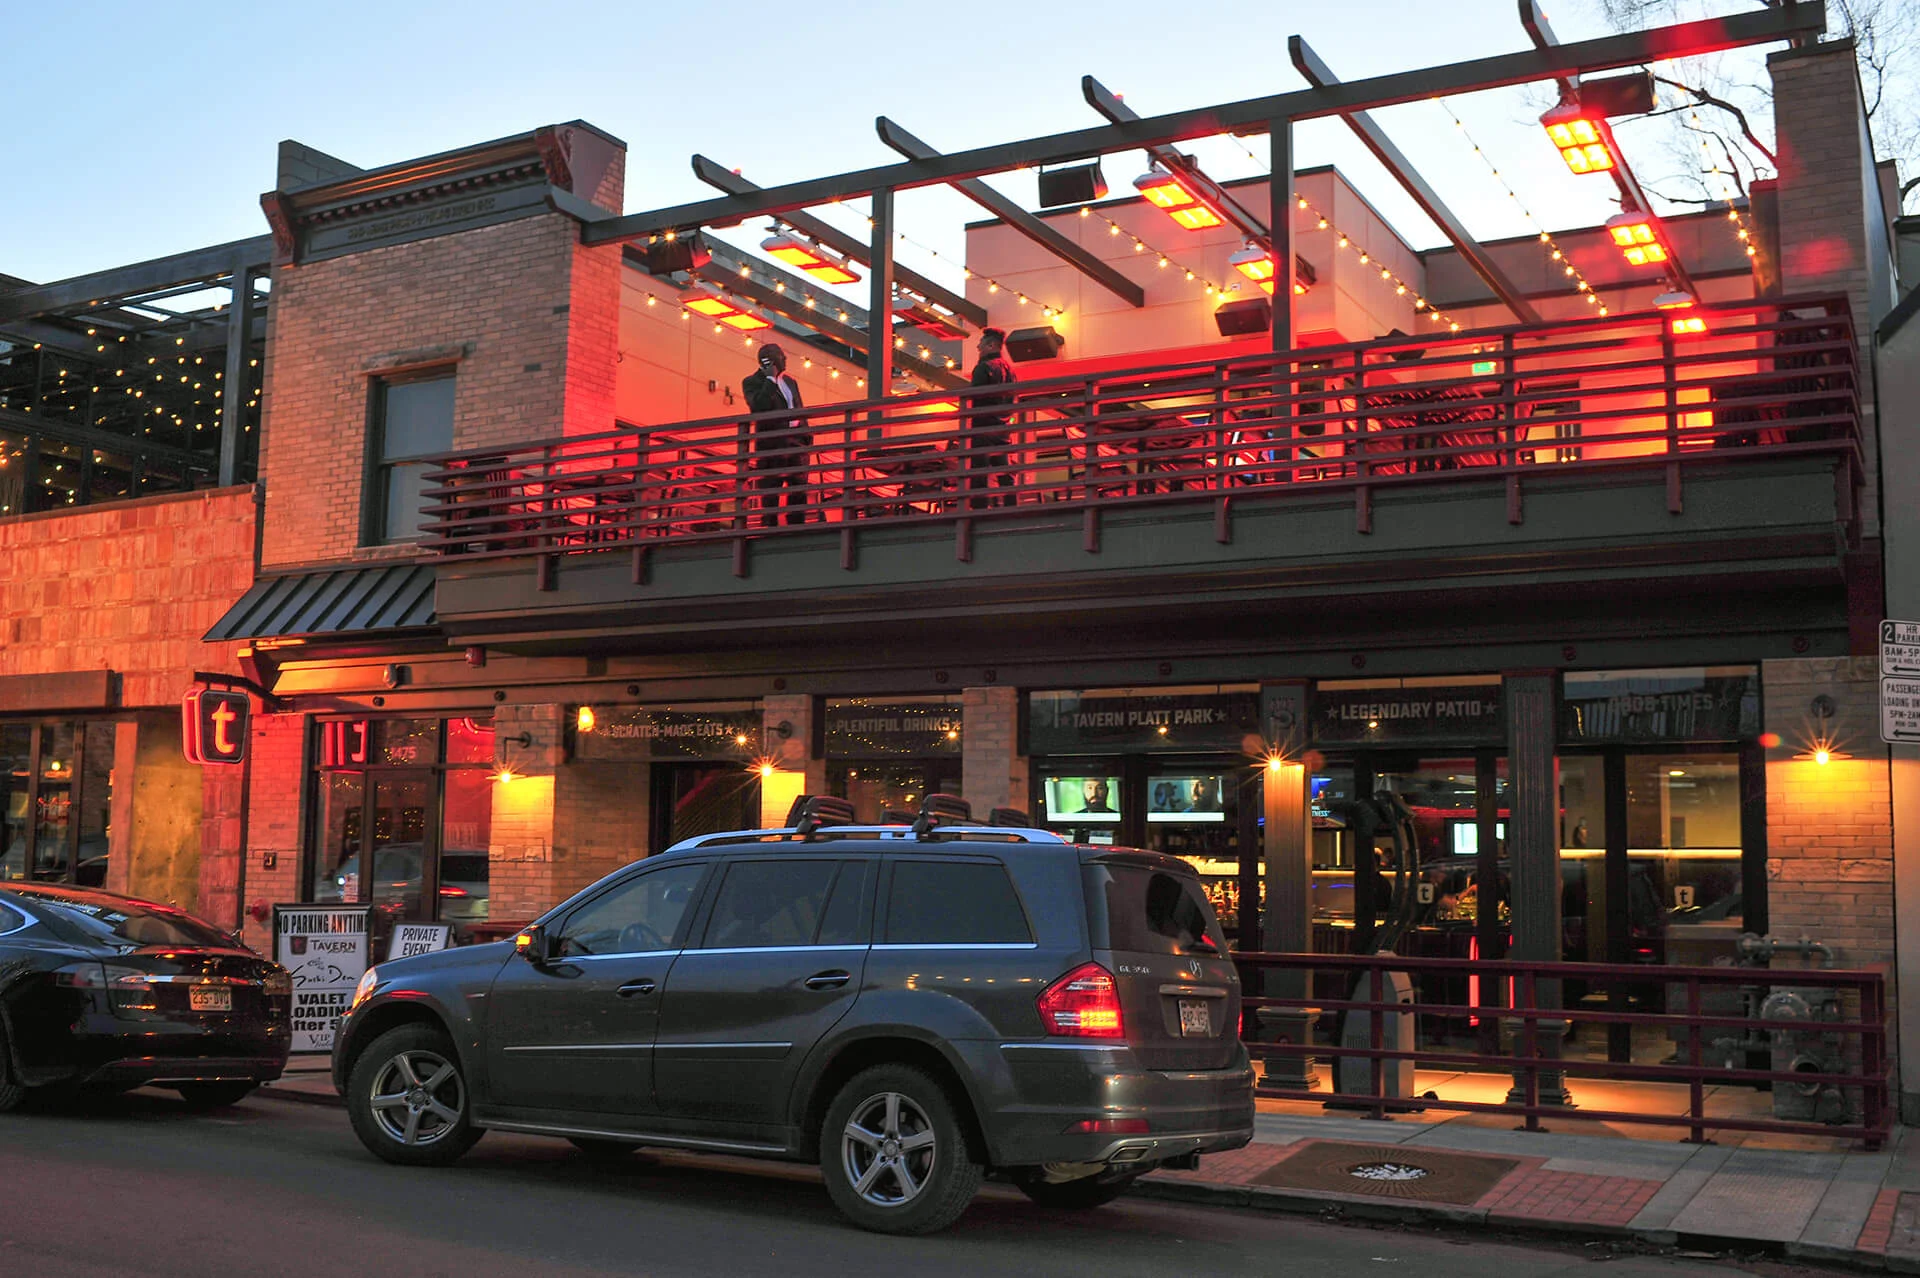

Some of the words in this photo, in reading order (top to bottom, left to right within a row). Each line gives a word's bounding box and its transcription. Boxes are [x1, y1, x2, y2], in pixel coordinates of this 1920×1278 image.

[1885, 624, 1893, 641] 2
[1906, 625, 1918, 633] HR
[1660, 693, 1714, 712] TIMES
[1884, 696, 1909, 707] LOADING
[1341, 702, 1432, 720] LEGENDARY
[1436, 700, 1481, 717] PATIO
[836, 717, 900, 733] PLENTIFUL
[903, 716, 950, 732] DRINKS
[1073, 711, 1124, 728] TAVERN
[1128, 710, 1171, 726] PLATT
[1174, 708, 1213, 724] PARK
[211, 700, 236, 754] t
[697, 722, 723, 736] EATS
[1680, 889, 1688, 904] t
[291, 914, 329, 934] PARKING
[402, 928, 440, 942] PRIVATE
[311, 940, 356, 951] TAVERN
[402, 943, 432, 955] EVENT
[327, 965, 355, 983] Den
[298, 993, 347, 1005] VALET
[291, 1006, 352, 1018] OADIN
[291, 1020, 325, 1031] fter
